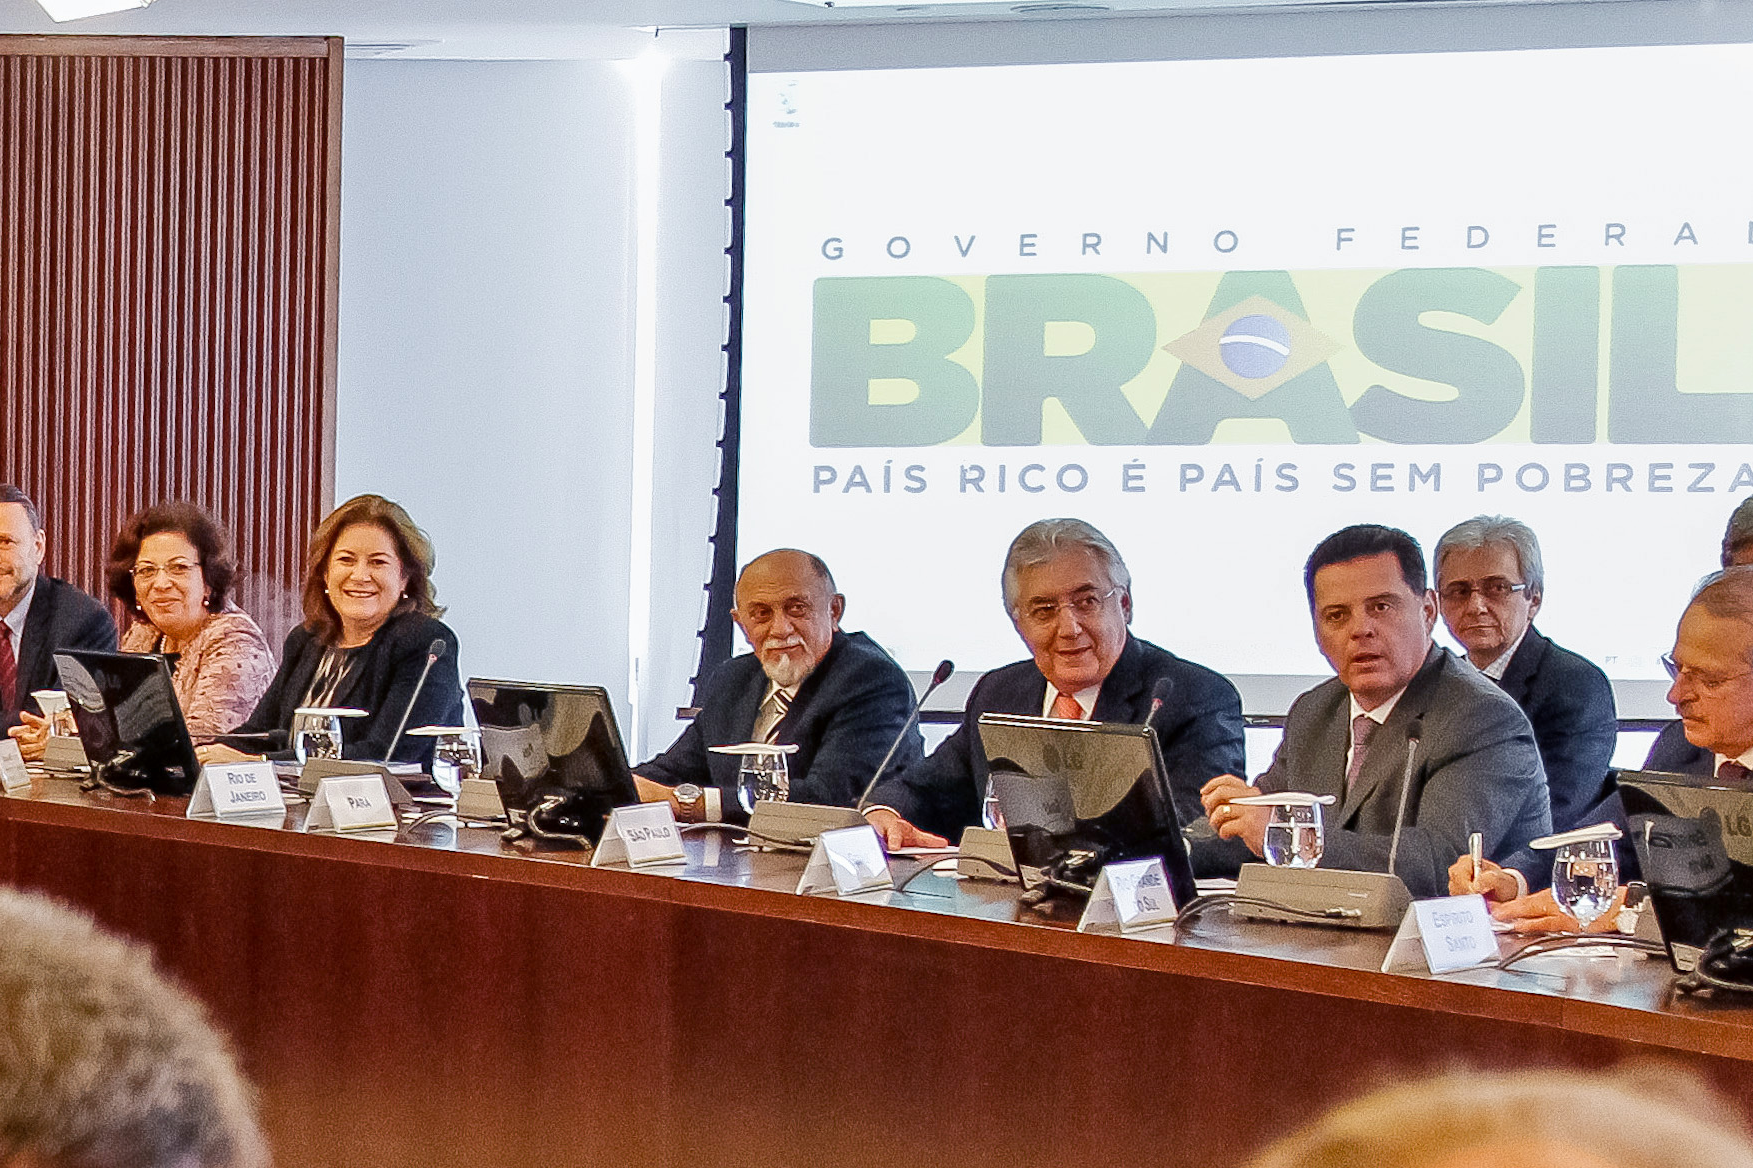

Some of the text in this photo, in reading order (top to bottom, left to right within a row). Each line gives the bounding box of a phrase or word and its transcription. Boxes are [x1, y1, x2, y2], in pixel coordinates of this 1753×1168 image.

[820, 229, 1239, 261] GOVERNO
[809, 264, 1753, 448] BRASIL
[812, 458, 1753, 494] PAÍS RICO É PAÍS SEM POBREZA
[227, 772, 257, 785] RIO DE
[230, 790, 266, 804] JANEIRO
